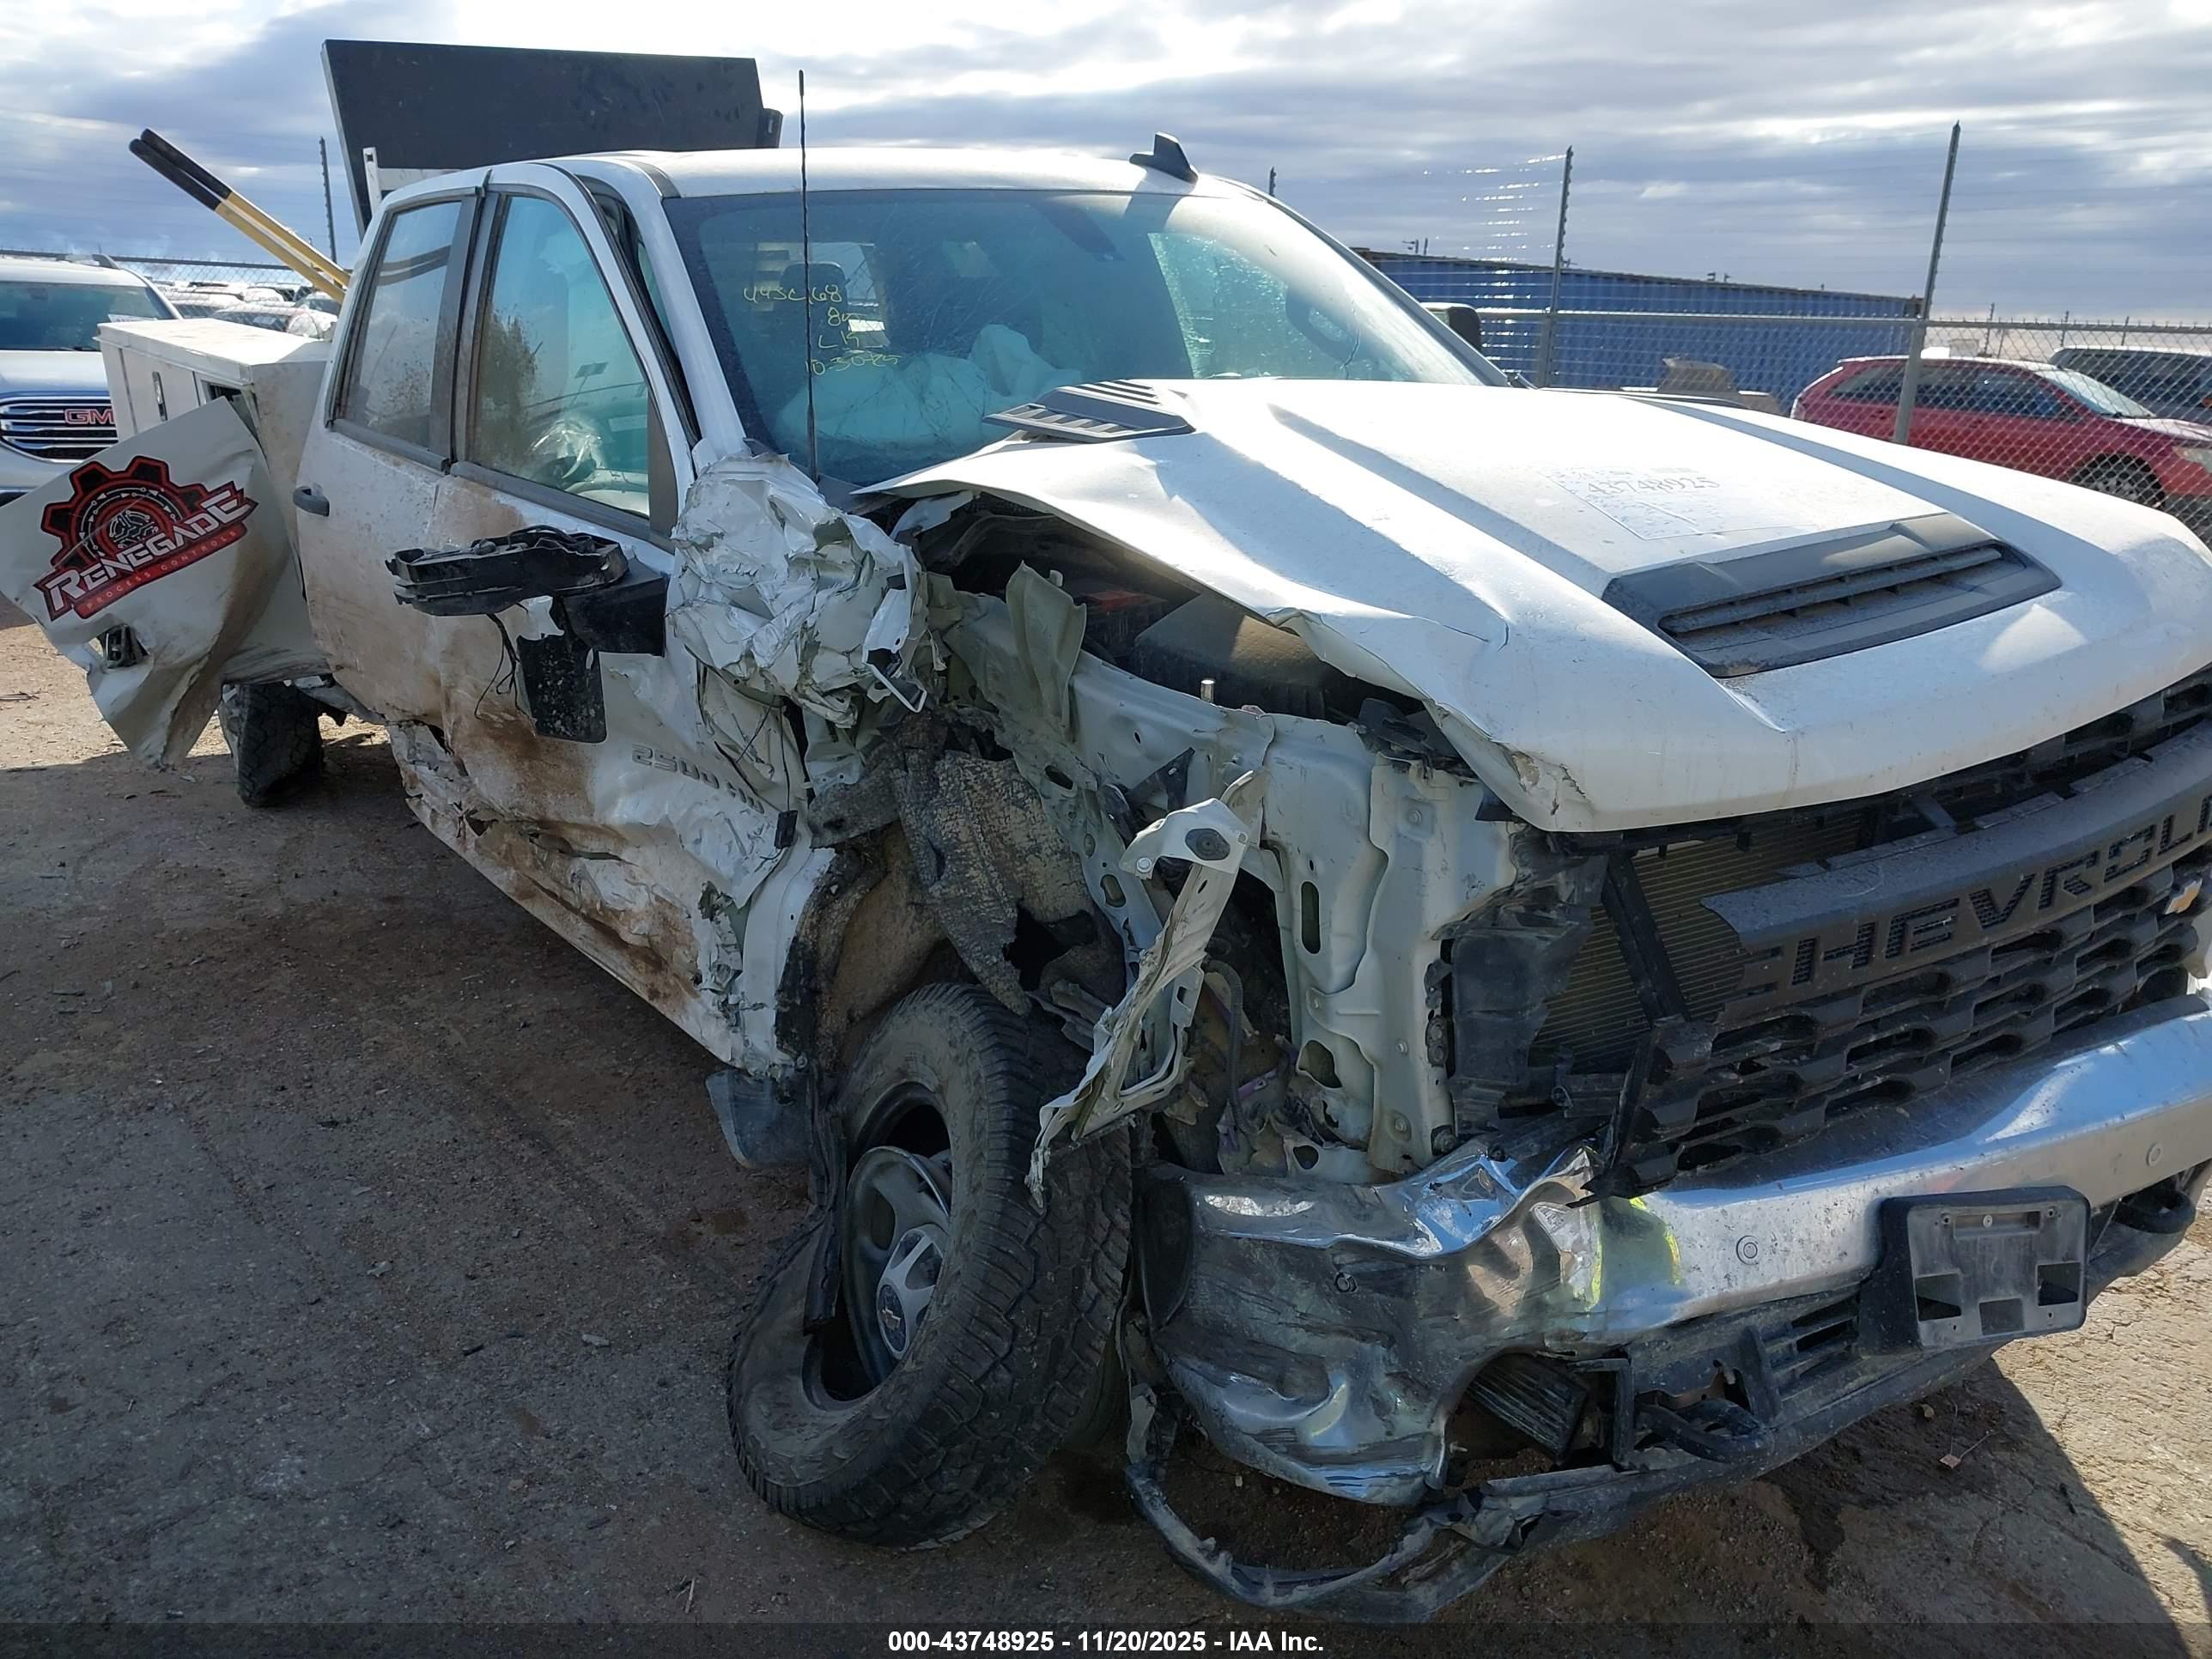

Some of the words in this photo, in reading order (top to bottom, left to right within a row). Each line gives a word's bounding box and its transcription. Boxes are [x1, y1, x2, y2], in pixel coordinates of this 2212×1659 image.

[64, 409, 115, 424] GM
[45, 489, 250, 611] RENEGADE
[87, 572, 150, 609] PROCESS
[161, 530, 237, 571] CONTROLS
[632, 744, 719, 788] 2500
